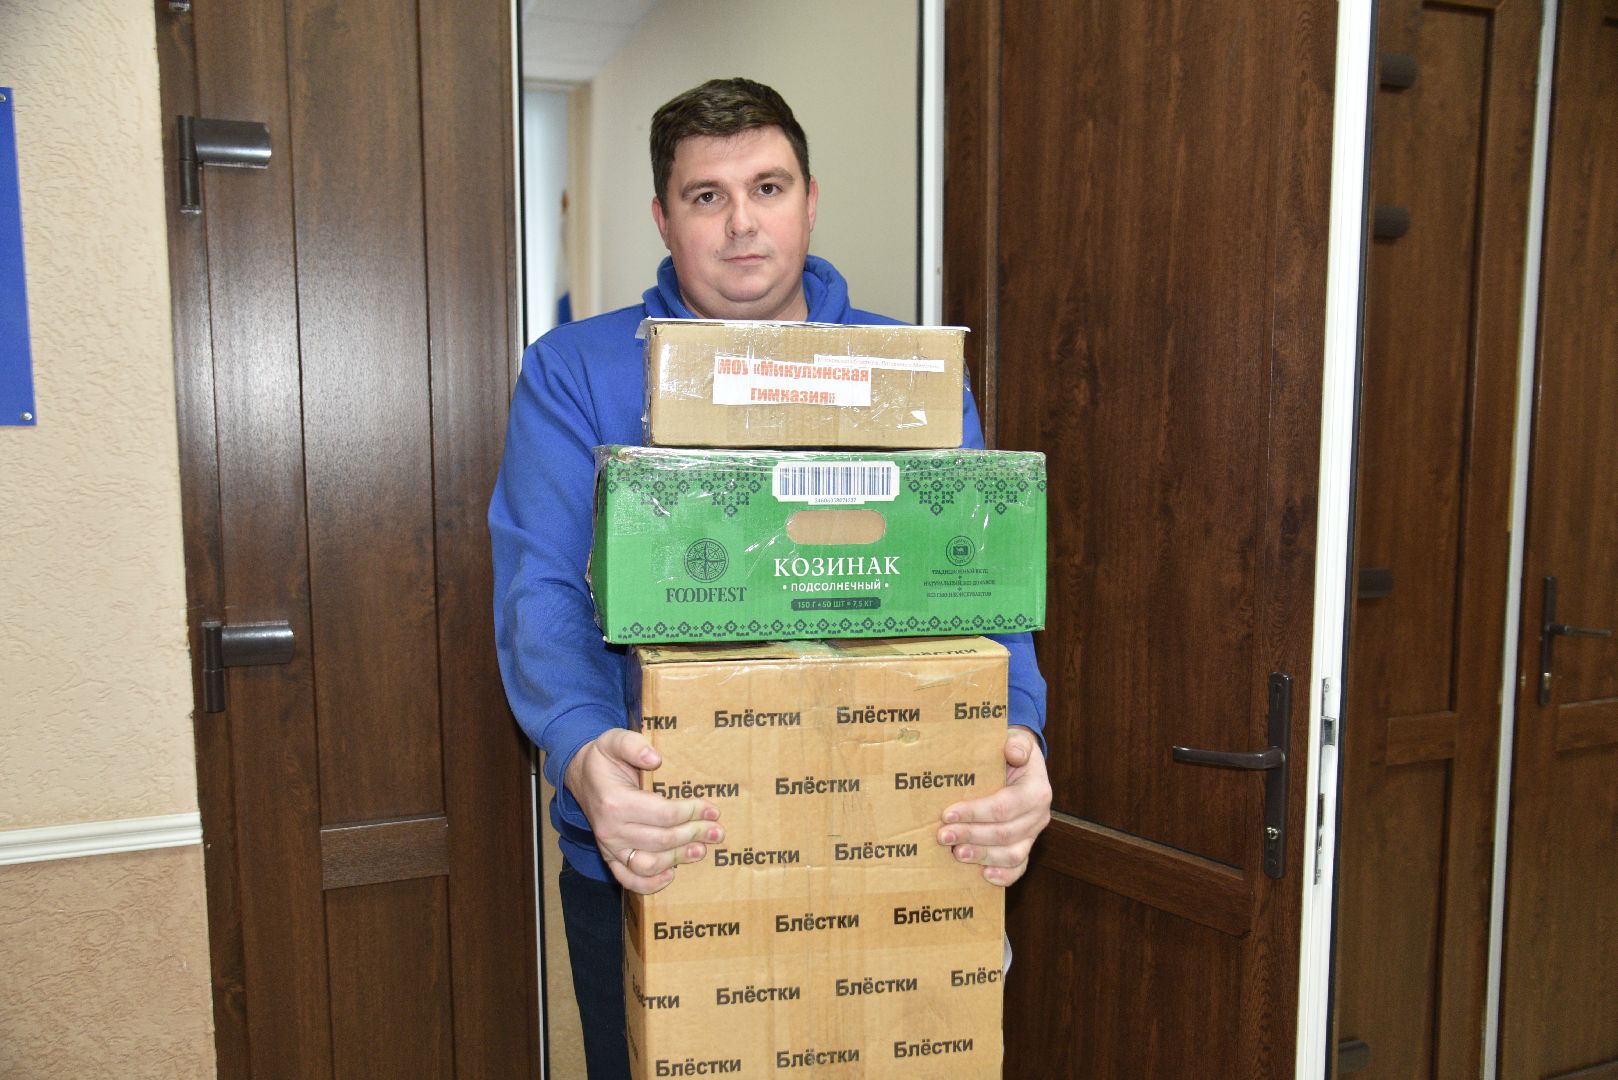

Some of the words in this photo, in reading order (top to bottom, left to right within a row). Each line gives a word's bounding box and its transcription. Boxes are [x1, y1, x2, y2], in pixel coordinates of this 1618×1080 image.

[754, 361, 869, 382] «Микулинская
[773, 556, 900, 577] КОЗИНАК
[665, 587, 748, 603] FOODFEST
[791, 579, 881, 593] ПОДСОЛНЕЧНЫЙ
[798, 601, 811, 609] 150
[834, 600, 845, 608] ШТ
[853, 600, 863, 609] 7,5
[864, 600, 874, 608] КГ
[641, 715, 677, 731] тки
[715, 708, 801, 728] Блёстки
[837, 704, 920, 724] Блёстки
[652, 780, 739, 799] Блёстки
[775, 776, 860, 795] Блёстки
[895, 771, 976, 790] Блёстки
[714, 847, 800, 867] Блёстки
[835, 841, 918, 861] Блёстки
[653, 920, 740, 940] Блёстки
[775, 913, 859, 933] Блёстки
[893, 905, 974, 925] Блёстки
[640, 994, 680, 1010] тки
[716, 985, 801, 1005] Блёстки
[835, 977, 918, 997] Блёстки
[655, 1058, 741, 1077] Блёстки
[776, 1048, 860, 1068] Блёстки
[893, 1037, 974, 1058] Блёстки
